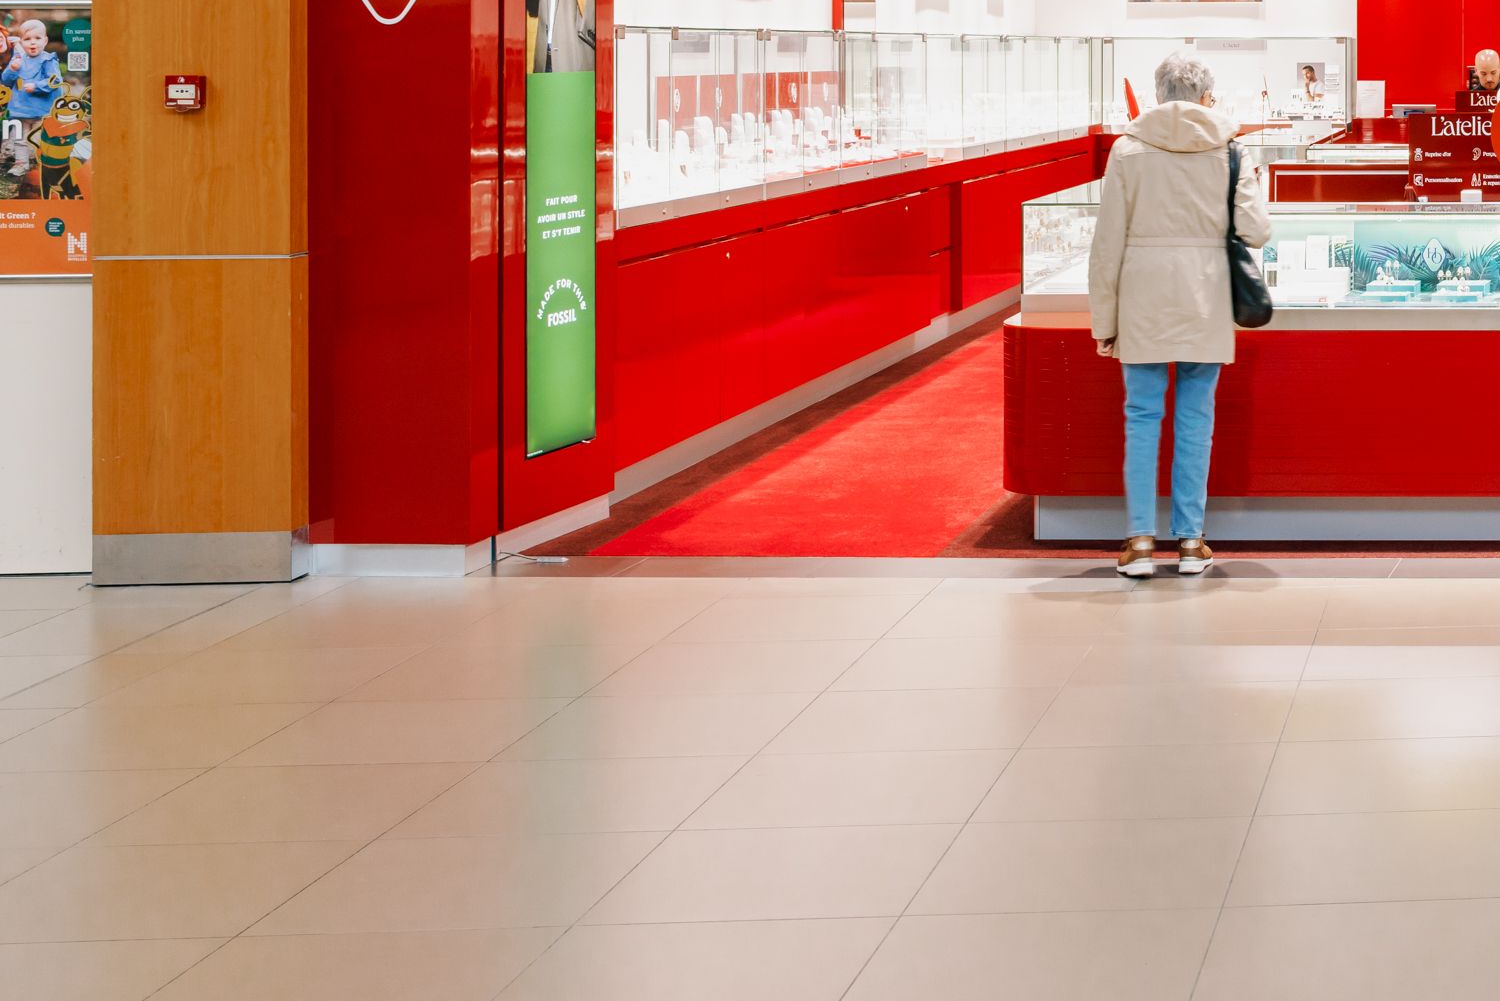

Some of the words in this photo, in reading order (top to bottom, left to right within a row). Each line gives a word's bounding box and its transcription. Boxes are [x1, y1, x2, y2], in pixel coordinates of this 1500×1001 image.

[1470, 92, 1498, 107] L'ate
[1431, 115, 1492, 137] L'atelie
[545, 197, 560, 206] FAIT
[560, 195, 578, 205] POUR
[6, 212, 29, 220] Green
[537, 213, 556, 224] AVOIR
[557, 211, 567, 221] UN
[567, 209, 586, 219] STYLE
[542, 230, 551, 239] ET
[562, 226, 581, 236] TENIR
[537, 285, 555, 320] MADE
[556, 278, 572, 289] FOR
[547, 308, 577, 327] FOSSIL
